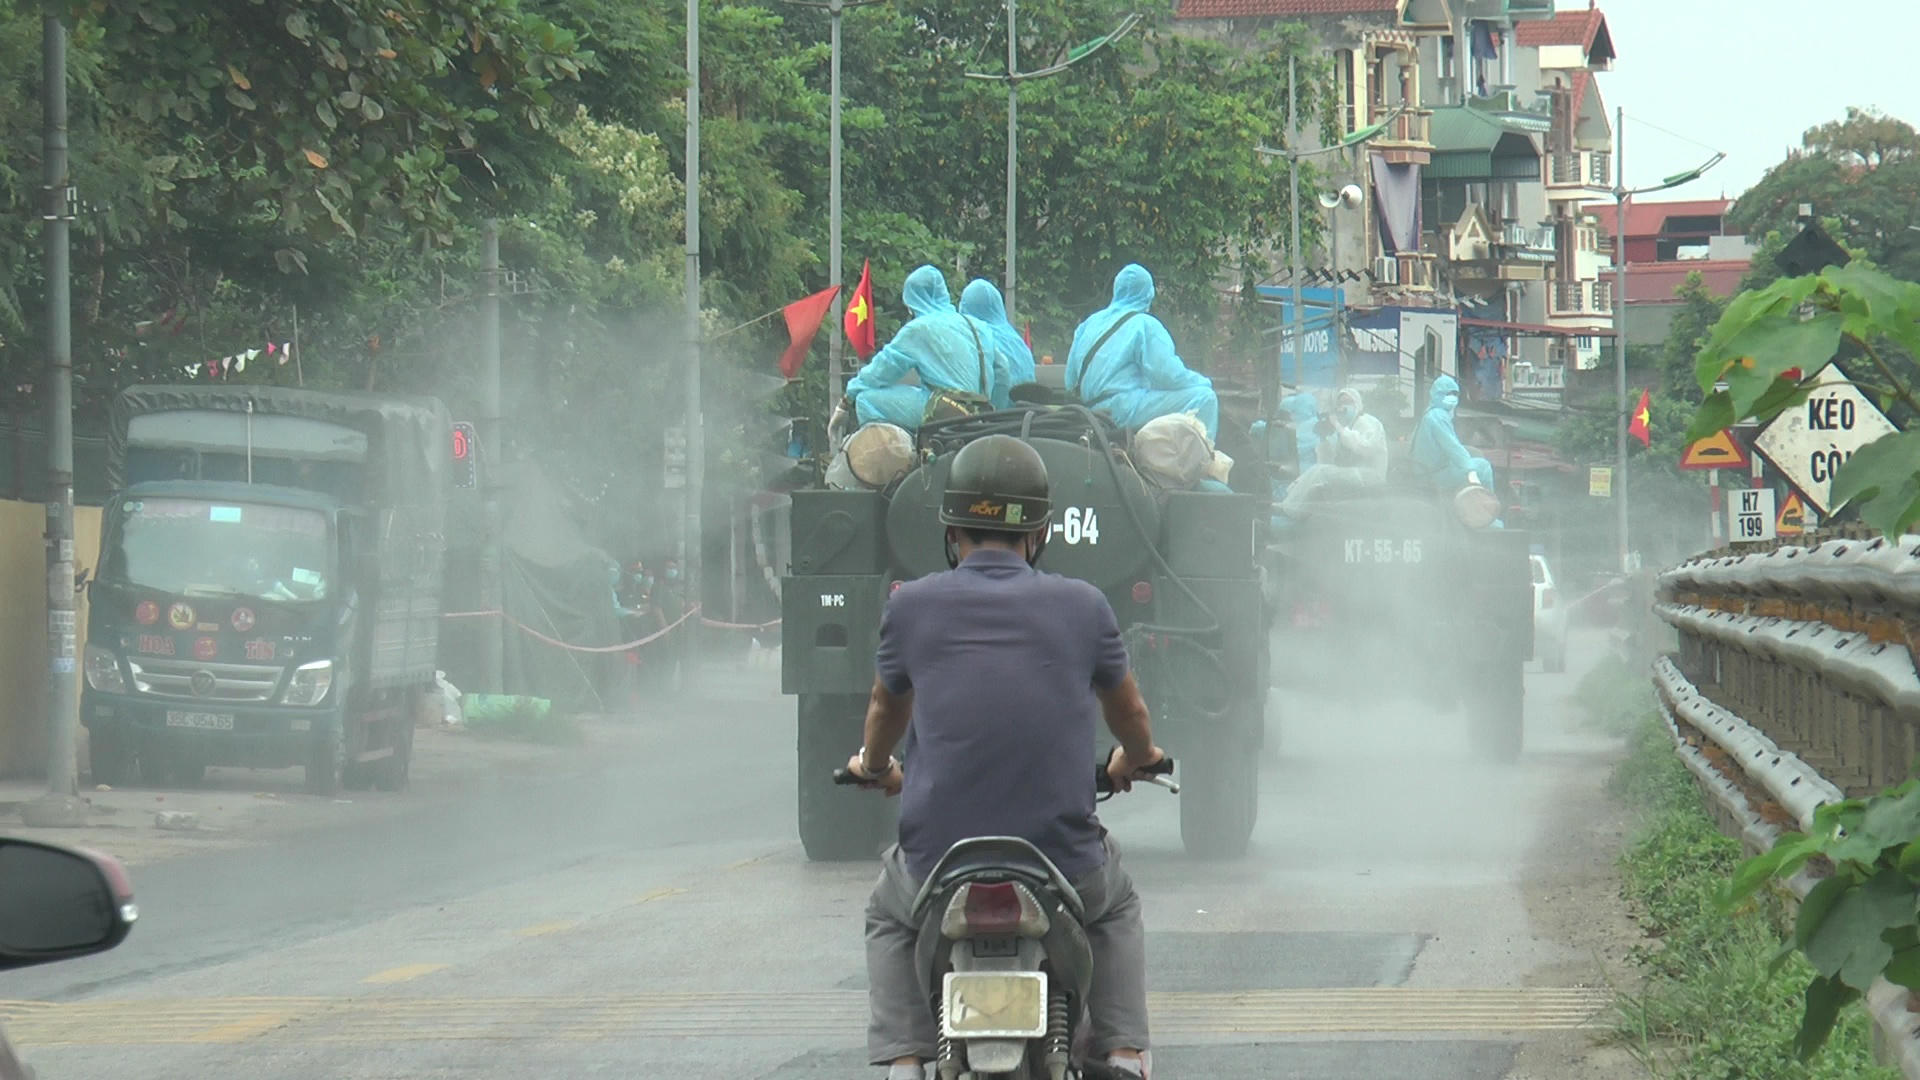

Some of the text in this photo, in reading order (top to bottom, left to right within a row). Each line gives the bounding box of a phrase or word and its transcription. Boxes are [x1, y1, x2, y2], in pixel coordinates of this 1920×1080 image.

[1809, 392, 1855, 430] KÉO
[1811, 443, 1850, 483] CÒ
[1742, 491, 1759, 512] H7
[1045, 506, 1099, 545] -64
[1739, 517, 1763, 537] 199
